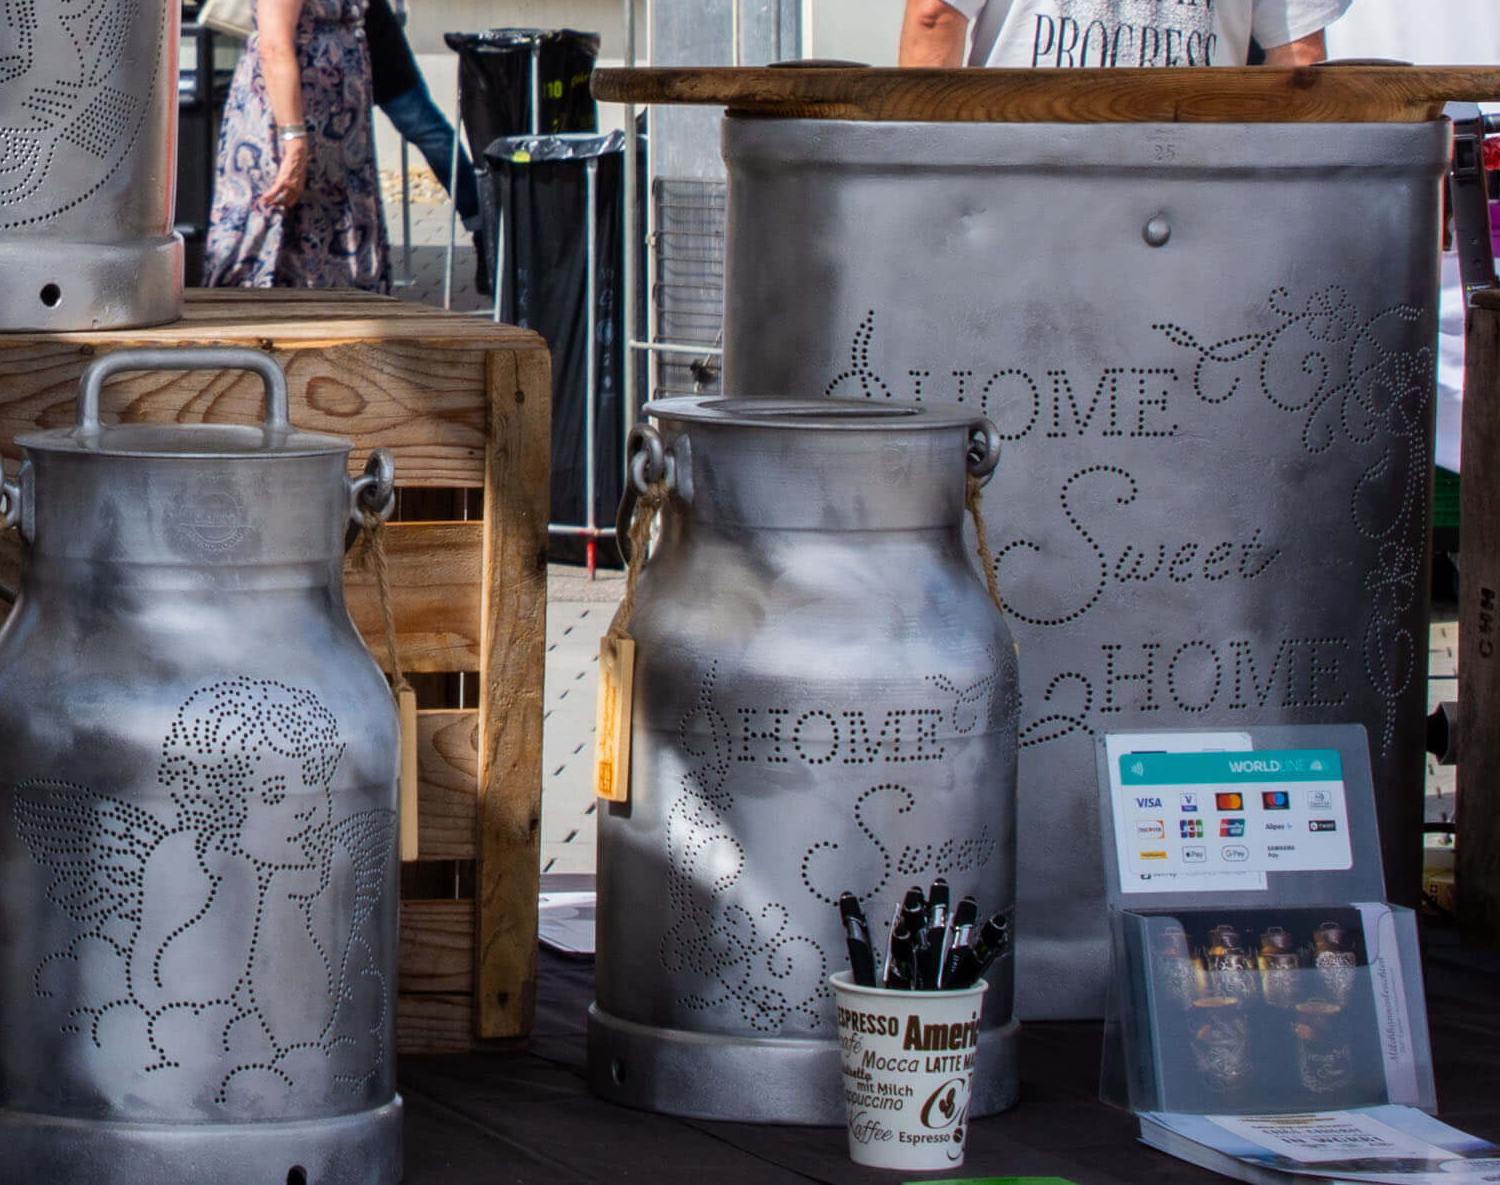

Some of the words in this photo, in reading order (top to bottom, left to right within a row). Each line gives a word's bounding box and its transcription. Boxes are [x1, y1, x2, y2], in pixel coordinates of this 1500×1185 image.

[993, 465, 1283, 627] Sweet
[1100, 636, 1350, 715] HOME
[737, 708, 945, 765] HOME
[1136, 797, 1163, 809] VISA
[861, 1049, 920, 1073] Mocca
[925, 1054, 962, 1073] LATTE
[856, 1081, 875, 1095] mit
[877, 1082, 914, 1097] Milch
[898, 1130, 950, 1146] Espresso
